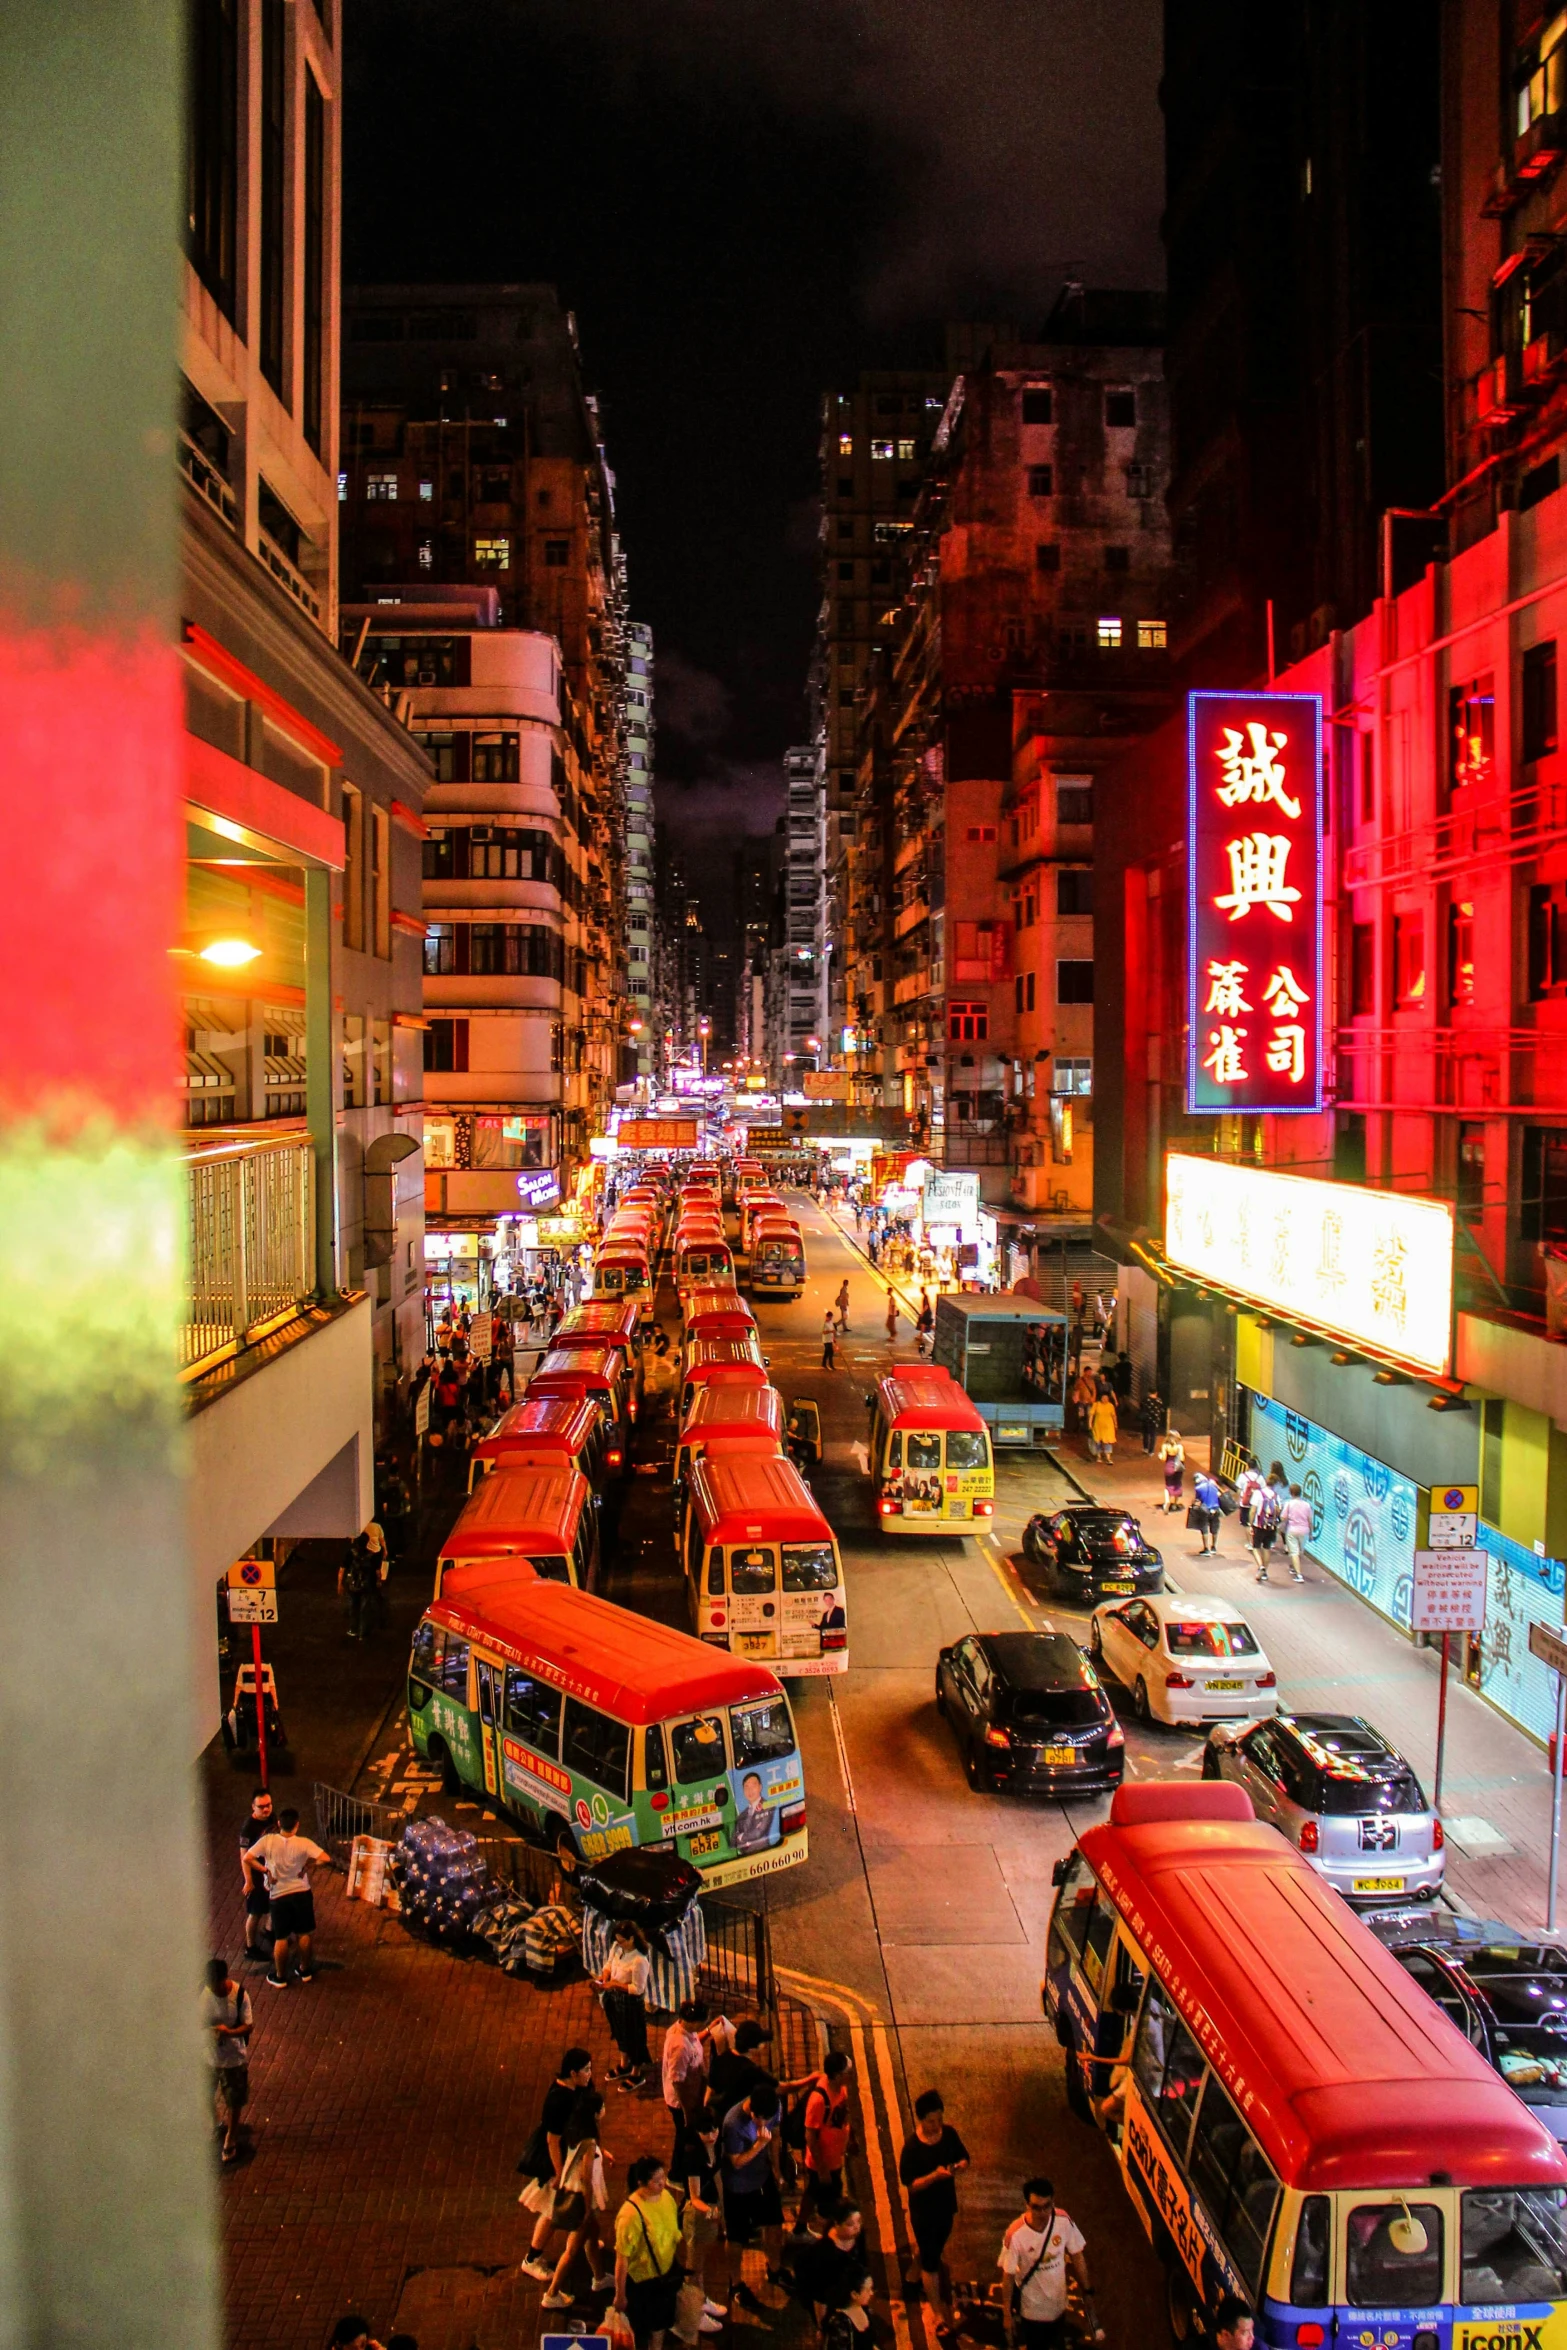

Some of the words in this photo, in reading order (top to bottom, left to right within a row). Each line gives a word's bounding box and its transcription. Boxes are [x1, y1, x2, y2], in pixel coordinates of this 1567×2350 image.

[1214, 722, 1302, 922] 誠興
[1262, 965, 1310, 1083] 公司
[518, 1174, 552, 1196] SALON
[531, 1185, 560, 1205] MORE
[1459, 1515, 1467, 1527] 7
[1460, 1534, 1473, 1546] 12
[258, 1590, 266, 1602] 7
[1427, 1590, 1472, 1599] 停車等候
[232, 1606, 257, 1614] midnight
[260, 1609, 275, 1621] 12
[447, 1616, 465, 1633] PUBLIC
[466, 1625, 482, 1642] LIGHT
[482, 1633, 494, 1648] BUS
[503, 1646, 522, 1662] SEATS
[1205, 1681, 1220, 1690] VN
[692, 1842, 719, 1856] 6048
[750, 1860, 769, 1876] 660
[771, 1853, 791, 1870] 660
[793, 1848, 805, 1862] 90
[1101, 1861, 1116, 1893] PUBLIC
[1116, 1887, 1134, 1916] LIGHT
[1131, 1914, 1146, 1935] BUS
[1151, 1944, 1172, 1976] SEATS
[1171, 1975, 1255, 2112] 公共小型巴士十六座位
[1472, 2305, 1516, 2320] 全球使用
[1463, 2327, 1544, 2350] iconX
